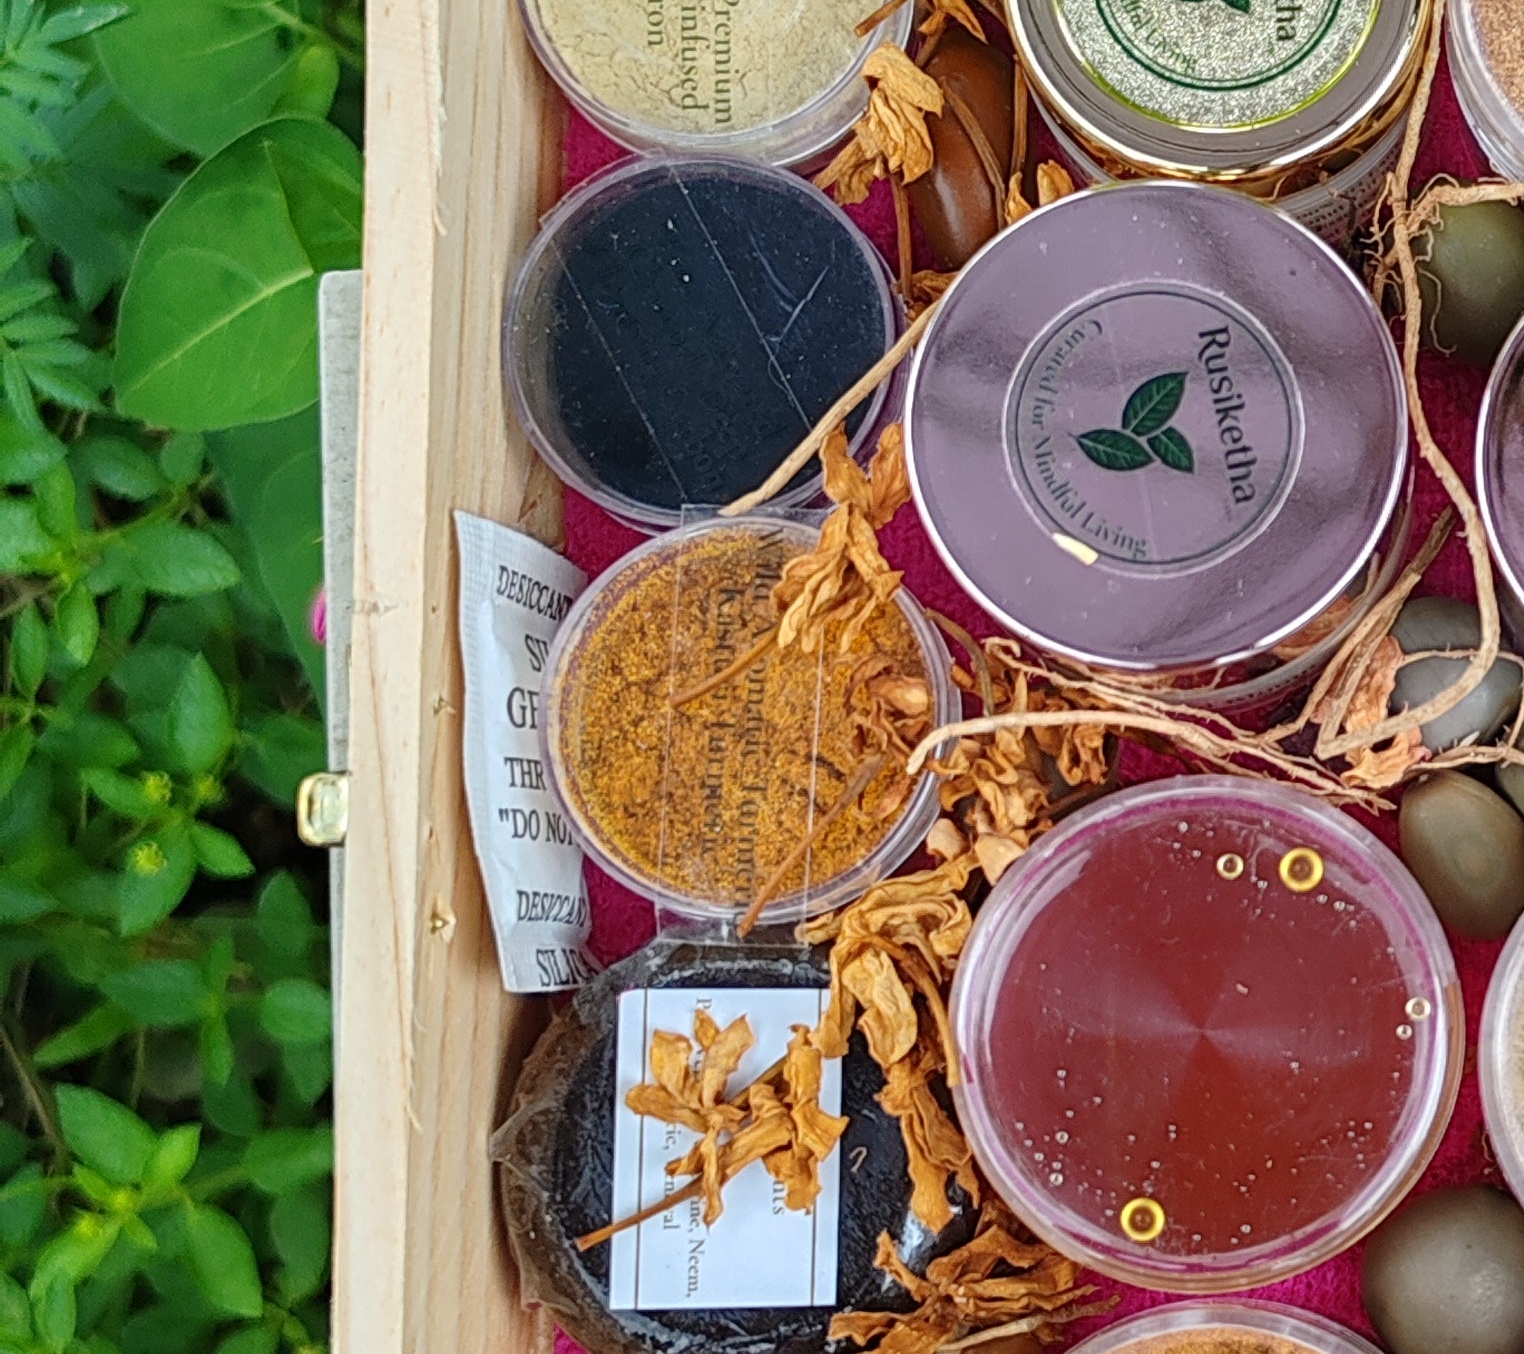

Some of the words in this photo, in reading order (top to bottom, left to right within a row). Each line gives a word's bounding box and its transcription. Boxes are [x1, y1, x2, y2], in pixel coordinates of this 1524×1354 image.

[679, 5, 710, 112] infused
[1037, 319, 1103, 393] Curated
[1030, 396, 1057, 432] for
[1197, 324, 1259, 506] Rusiketha
[1030, 434, 1087, 520] Mindful
[1077, 513, 1149, 560] Living
[711, 586, 746, 701] Kastui
[741, 614, 779, 758] Aomatic
[504, 756, 548, 794] THR
[684, 1238, 706, 1299] Neem,
